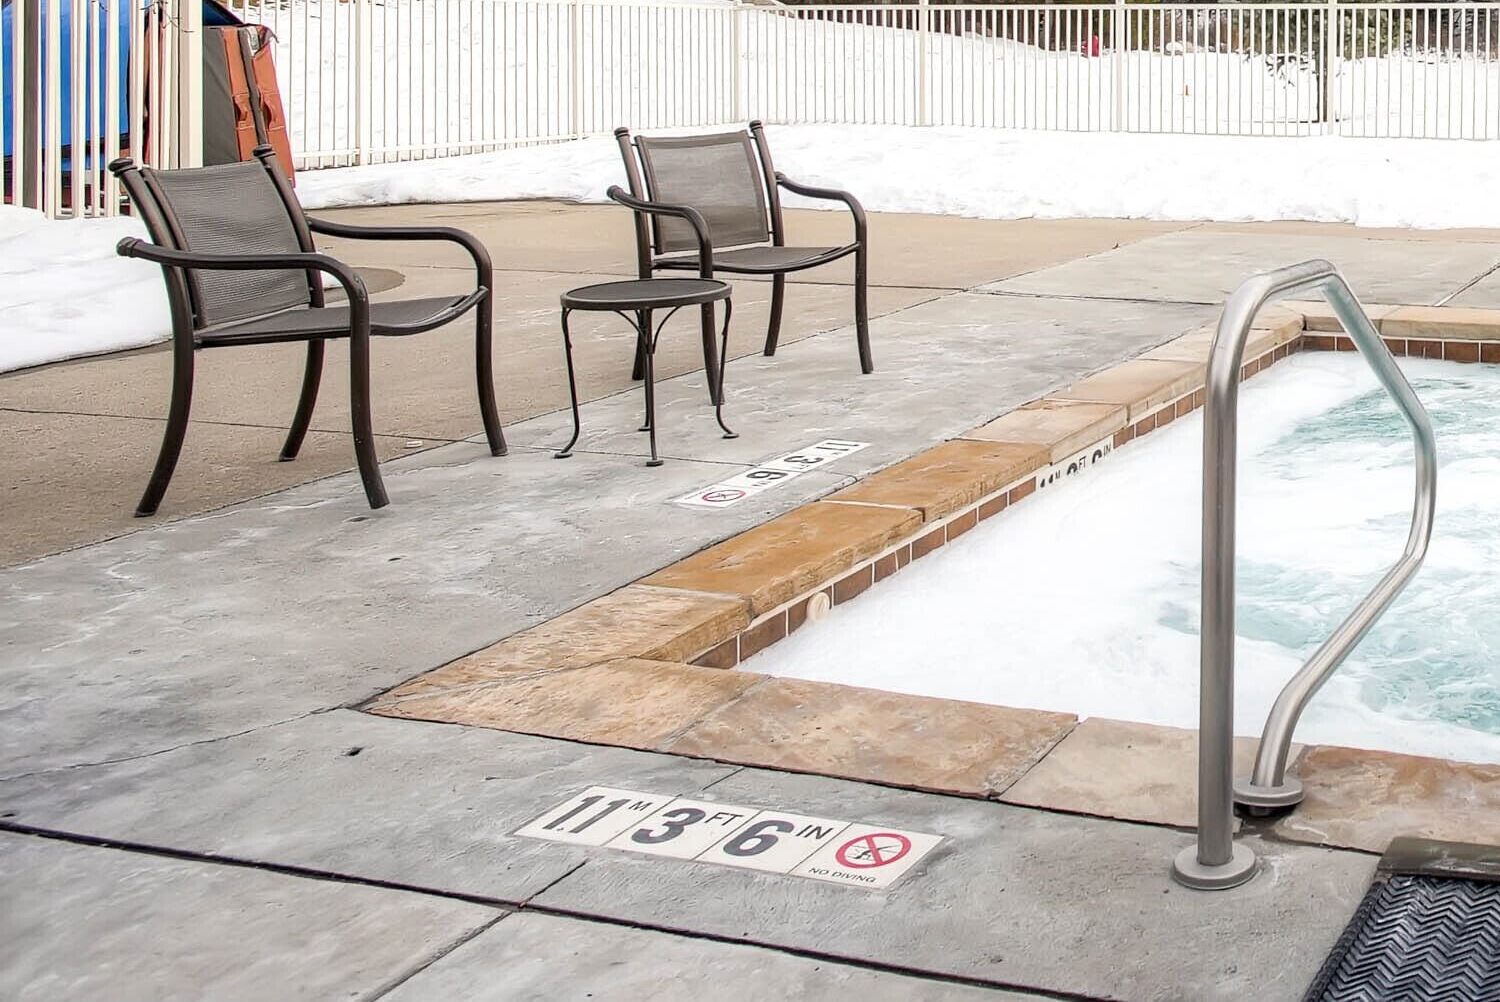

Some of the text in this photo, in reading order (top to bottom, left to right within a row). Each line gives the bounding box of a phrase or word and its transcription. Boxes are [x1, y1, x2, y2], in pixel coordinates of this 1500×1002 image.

[628, 800, 653, 811] M
[631, 807, 706, 844] 3
[704, 811, 744, 826] FT
[723, 819, 795, 857] 6
[795, 824, 833, 840] IN
[808, 867, 877, 883] NO DIVING
